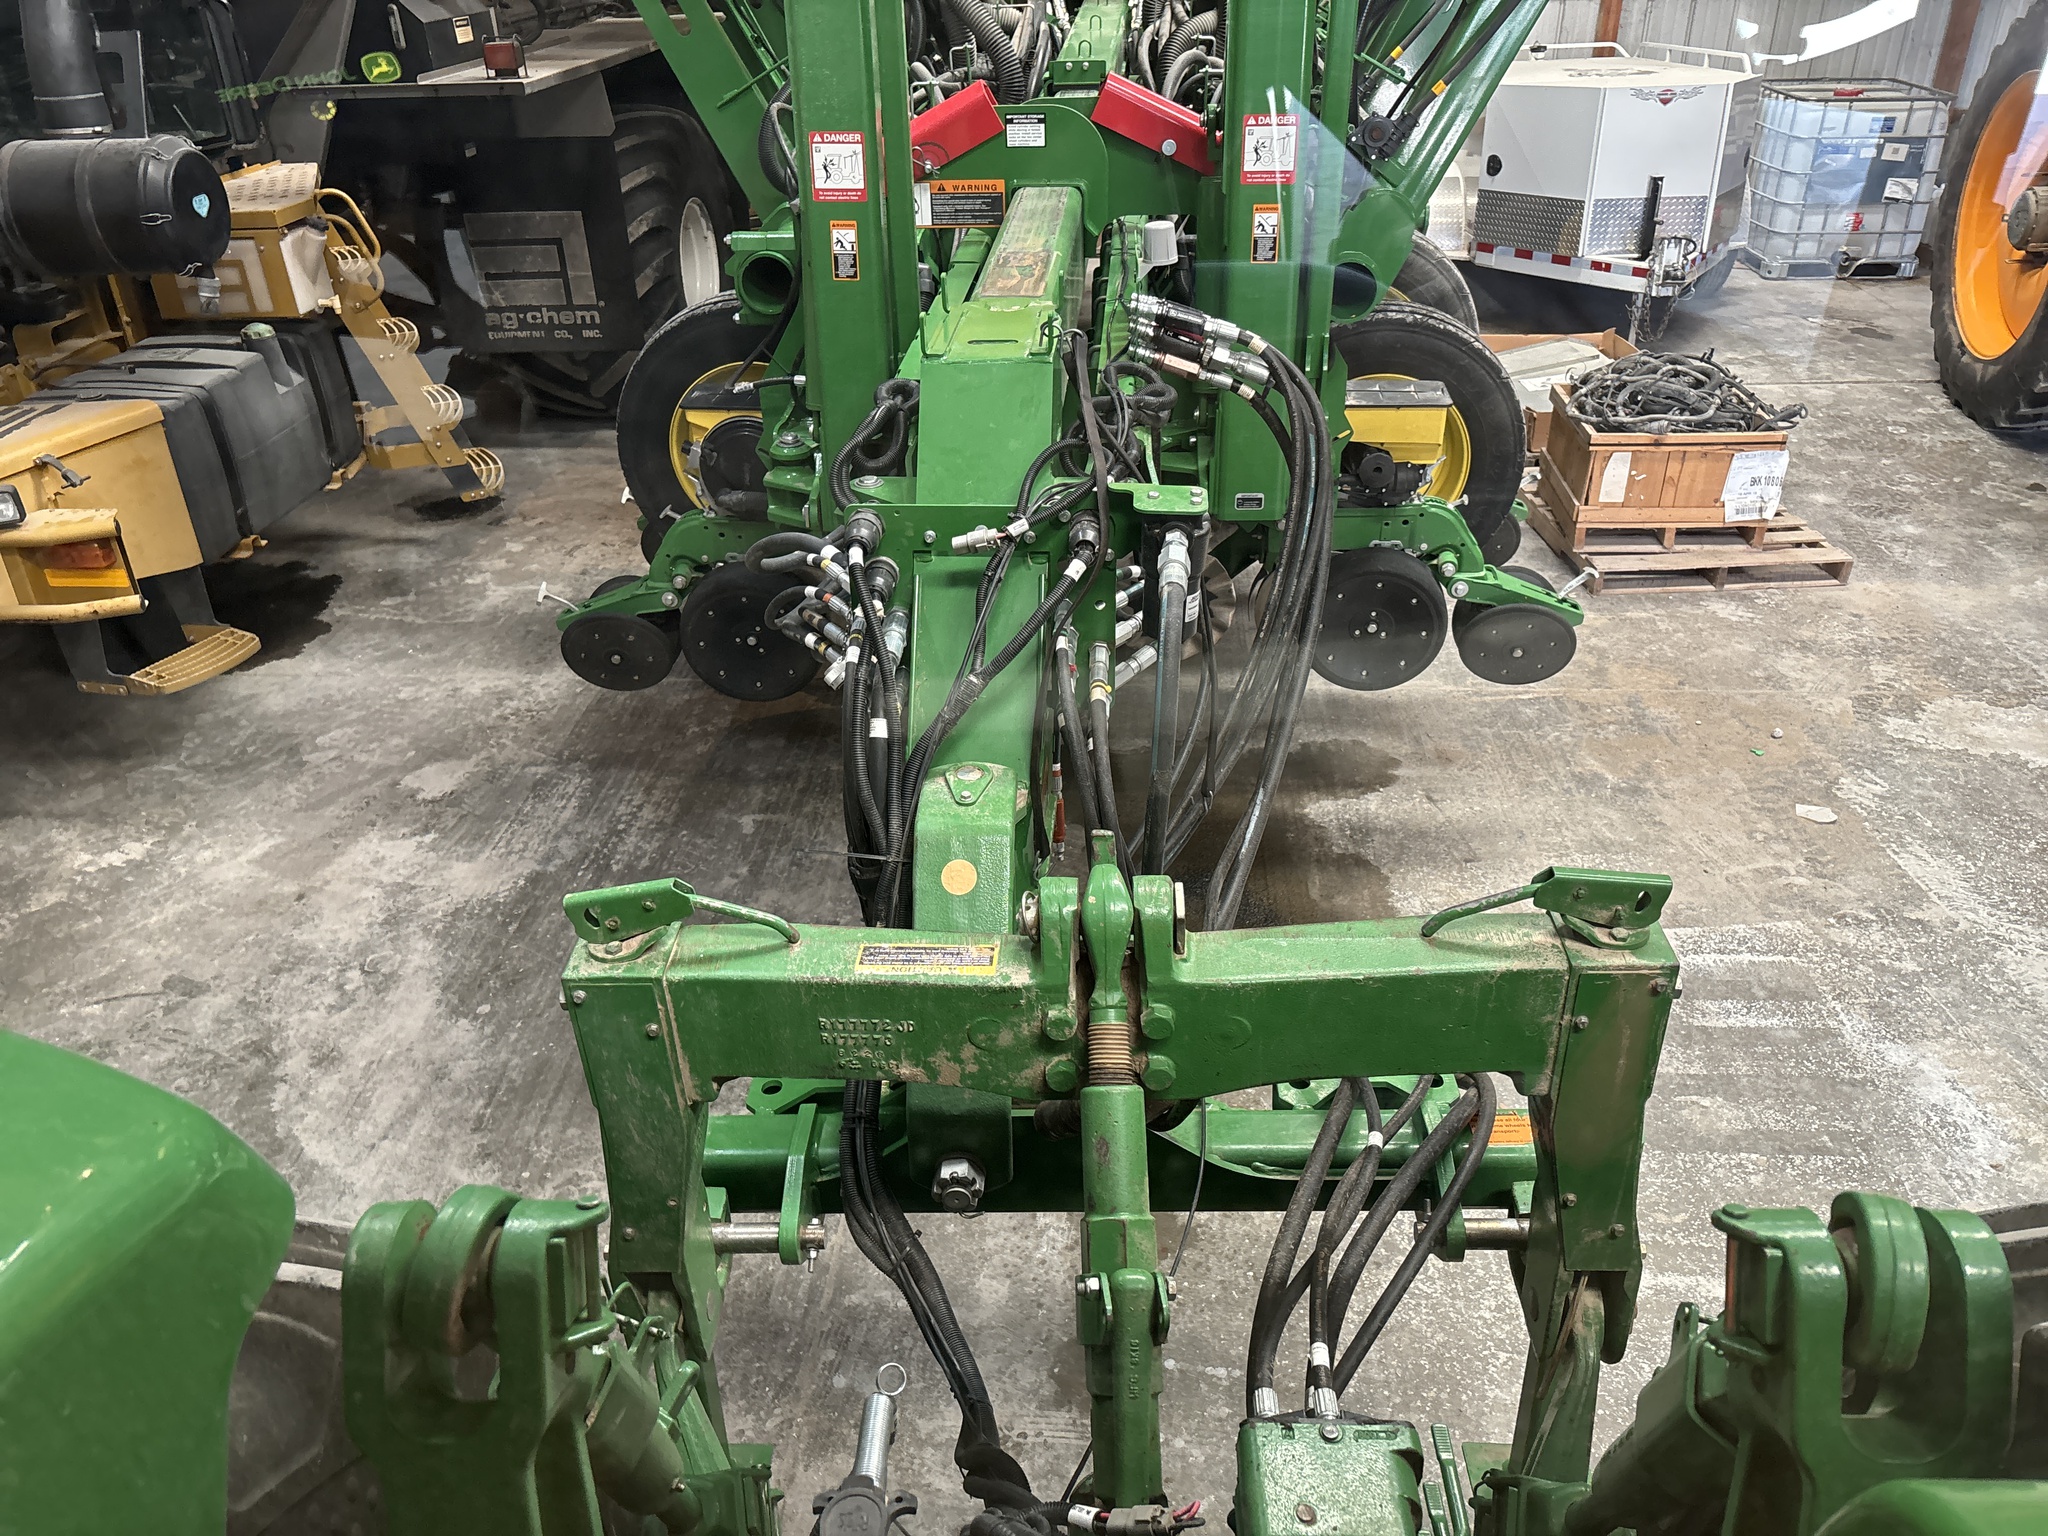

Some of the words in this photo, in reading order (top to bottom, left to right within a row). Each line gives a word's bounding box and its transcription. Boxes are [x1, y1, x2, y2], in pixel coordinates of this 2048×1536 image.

[1258, 116, 1296, 124] DAGER
[823, 134, 861, 142] DANGER
[1750, 476, 1763, 487] BKK
